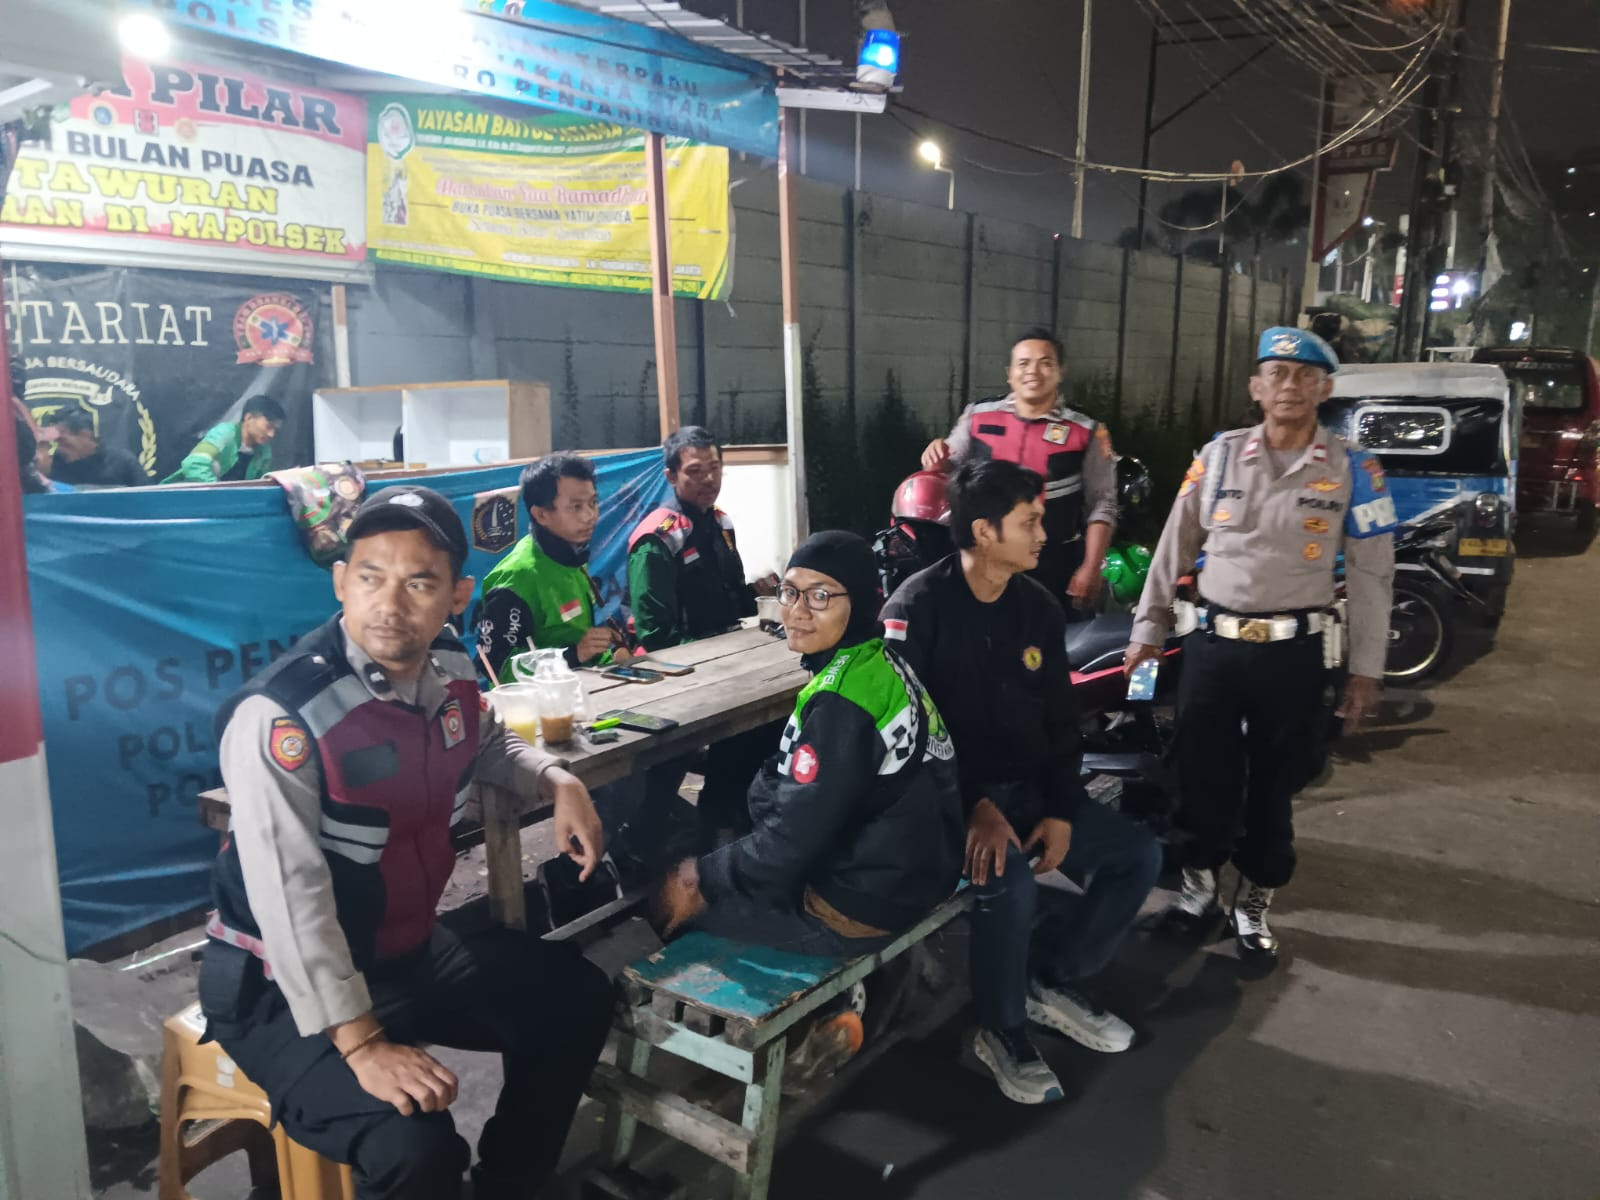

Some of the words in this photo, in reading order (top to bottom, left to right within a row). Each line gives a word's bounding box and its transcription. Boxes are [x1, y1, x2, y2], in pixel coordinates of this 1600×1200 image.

[150, 65, 341, 135] PILAR
[417, 109, 489, 134] YAYASAN
[14, 156, 279, 215] TAWURAN
[67, 130, 190, 169] BULAN
[202, 150, 314, 187] PUASA
[104, 203, 149, 233] DI
[168, 211, 347, 255] MAPOLSEK
[64, 658, 183, 721] POS
